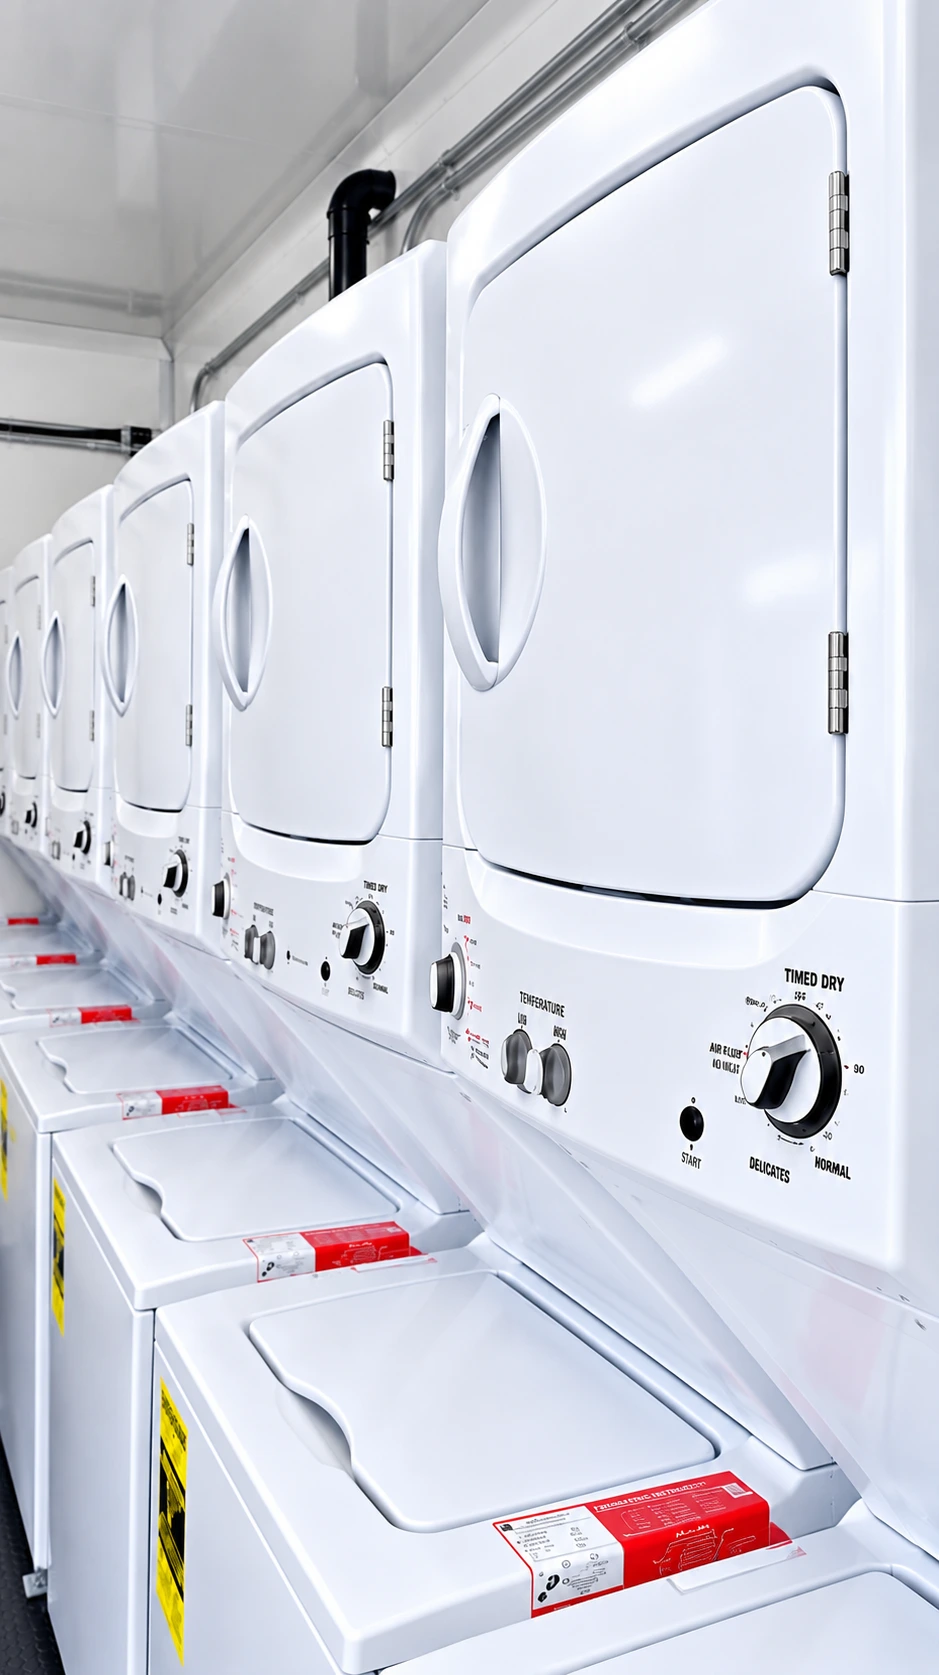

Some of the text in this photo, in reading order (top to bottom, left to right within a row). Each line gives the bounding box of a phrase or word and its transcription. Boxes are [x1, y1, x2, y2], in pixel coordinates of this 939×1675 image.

[784, 968, 845, 992] TIMED DRY
[853, 1064, 865, 1075] 90
[681, 1151, 702, 1170] START
[749, 1156, 791, 1184] DELICATES
